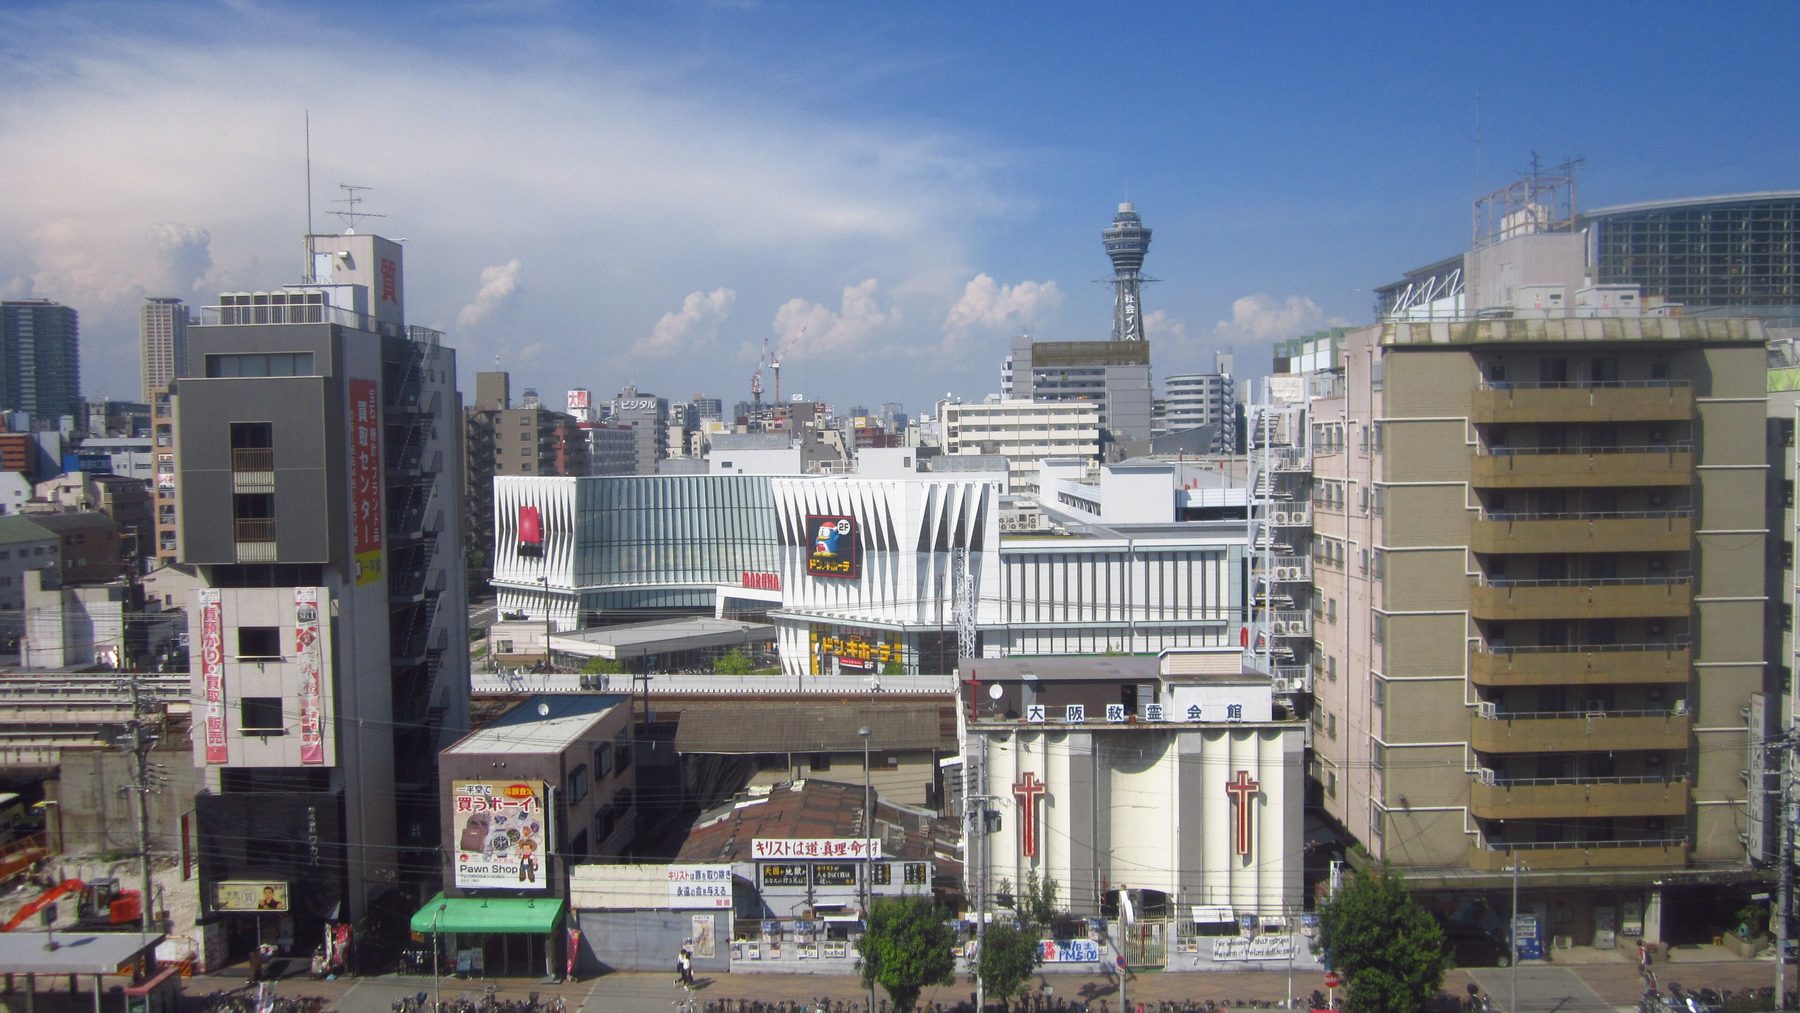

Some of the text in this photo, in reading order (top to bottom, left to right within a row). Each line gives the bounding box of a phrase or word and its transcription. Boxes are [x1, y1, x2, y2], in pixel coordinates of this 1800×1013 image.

[838, 522, 849, 532] 2F
[1028, 704, 1243, 721] 大阪救霊会館
[460, 864, 518, 875] Pawn Shop
